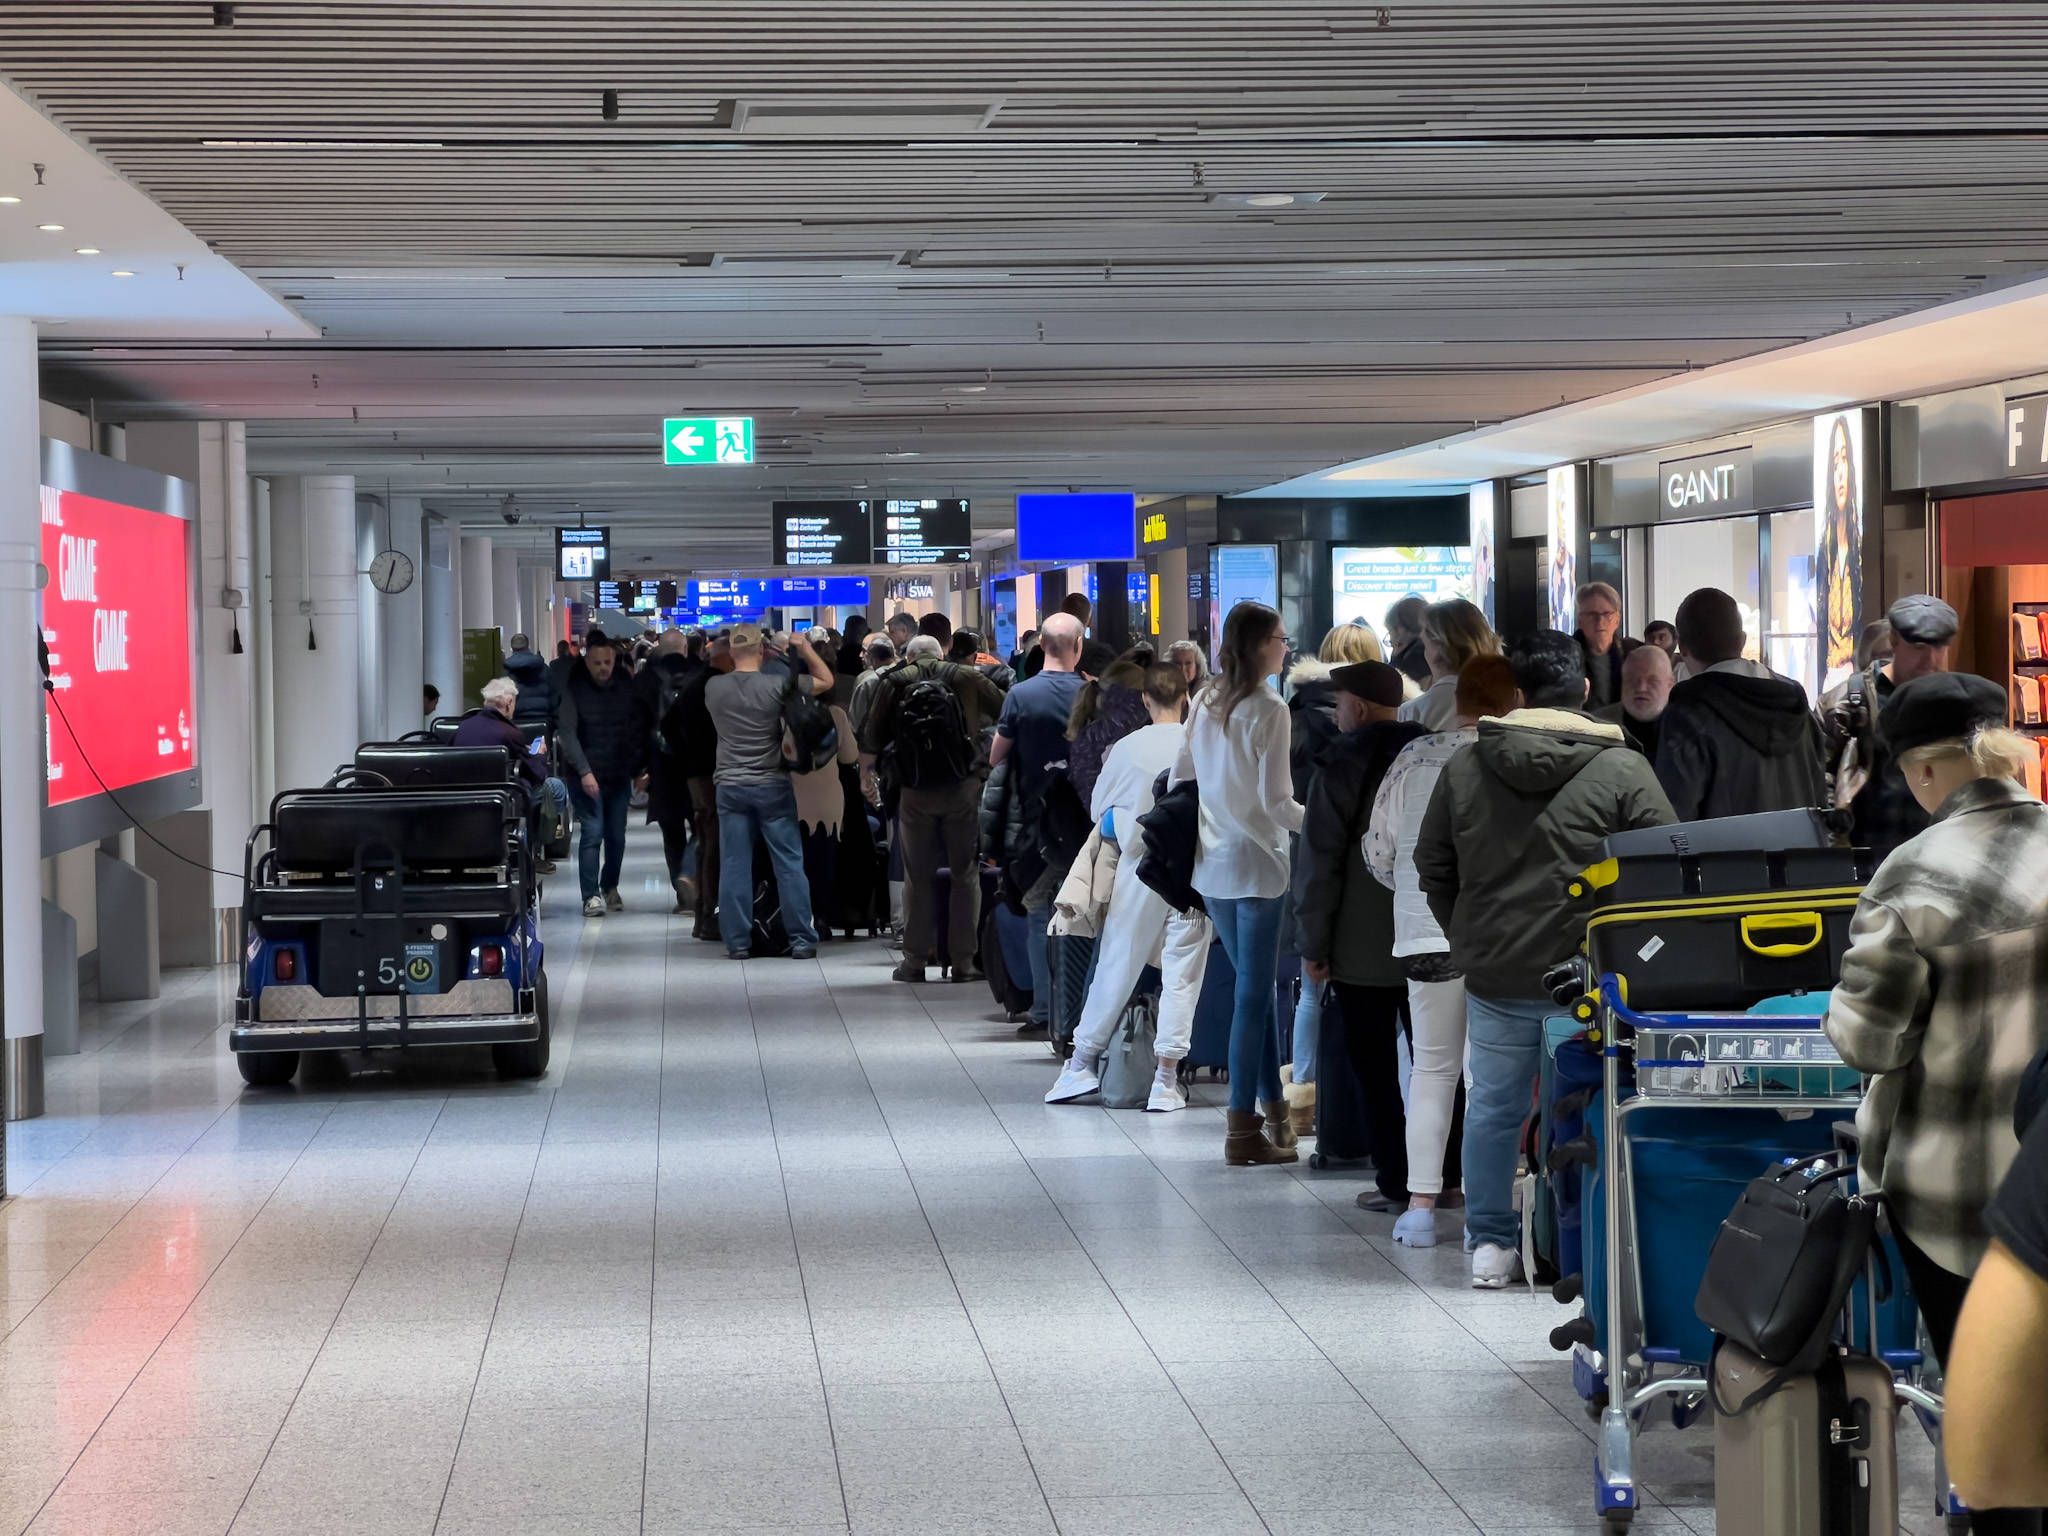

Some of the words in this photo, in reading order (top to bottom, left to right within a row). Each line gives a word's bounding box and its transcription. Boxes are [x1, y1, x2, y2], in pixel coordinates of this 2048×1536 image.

[1667, 464, 1735, 508] GANT
[59, 533, 97, 602] GIMME
[1346, 564, 1370, 573] Great
[1372, 563, 1402, 573] brands
[1402, 563, 1419, 575] just
[1420, 565, 1427, 573] a
[1428, 563, 1444, 573] few
[1445, 563, 1467, 574] steps
[730, 581, 738, 592] C
[819, 580, 826, 591] B
[908, 585, 934, 598] SWA
[1346, 581, 1384, 591] Discover
[1385, 580, 1408, 591] them
[1410, 580, 1433, 590] now!
[733, 595, 749, 606] D,E
[93, 608, 129, 672] GIMME
[377, 957, 397, 984] 5
